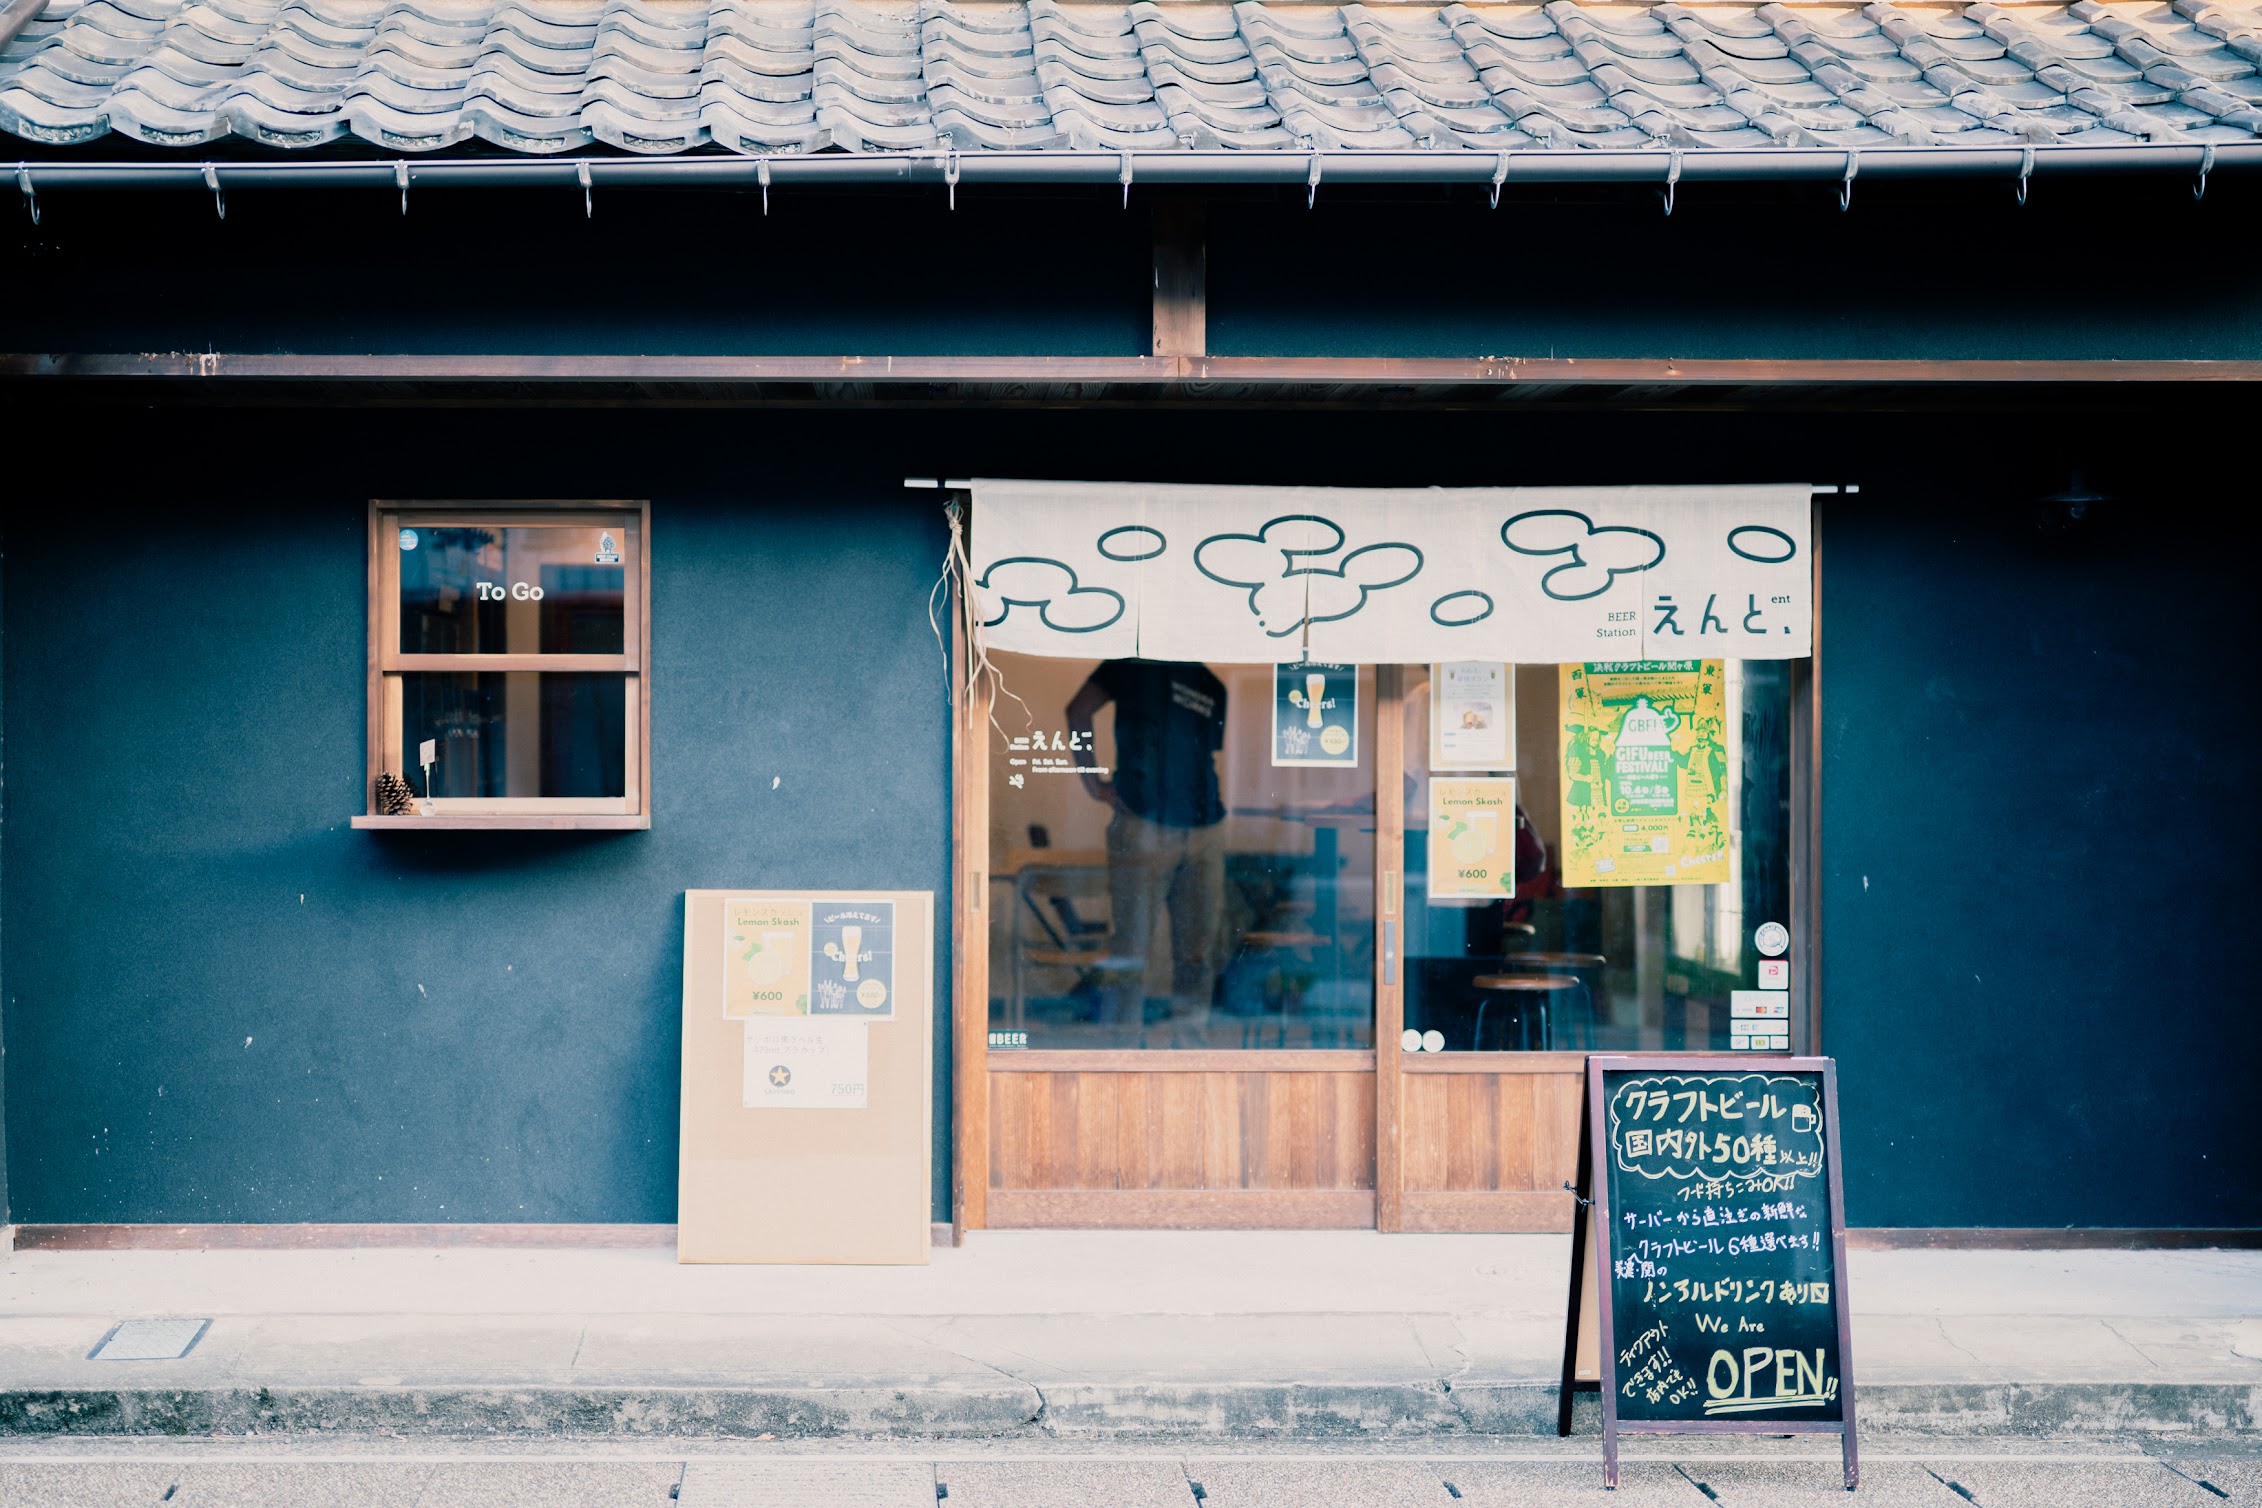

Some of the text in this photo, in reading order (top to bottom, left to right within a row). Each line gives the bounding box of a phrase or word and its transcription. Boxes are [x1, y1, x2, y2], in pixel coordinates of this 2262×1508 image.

[476, 582, 544, 601] To Go
[1771, 594, 1791, 604] ent
[1607, 611, 1636, 622] BEER
[1596, 628, 1636, 638] Station
[1628, 719, 1657, 732] GBF!
[1616, 746, 1648, 761] GIFU
[1443, 797, 1503, 806] Lemon Skash
[1458, 869, 1487, 879] ¥600
[737, 917, 800, 926] Lemon Skash
[752, 991, 783, 1001] ¥600
[831, 1083, 864, 1095] 750円
[1625, 1090, 1787, 1123] クラフトビール
[1695, 1313, 1765, 1334] We Are
